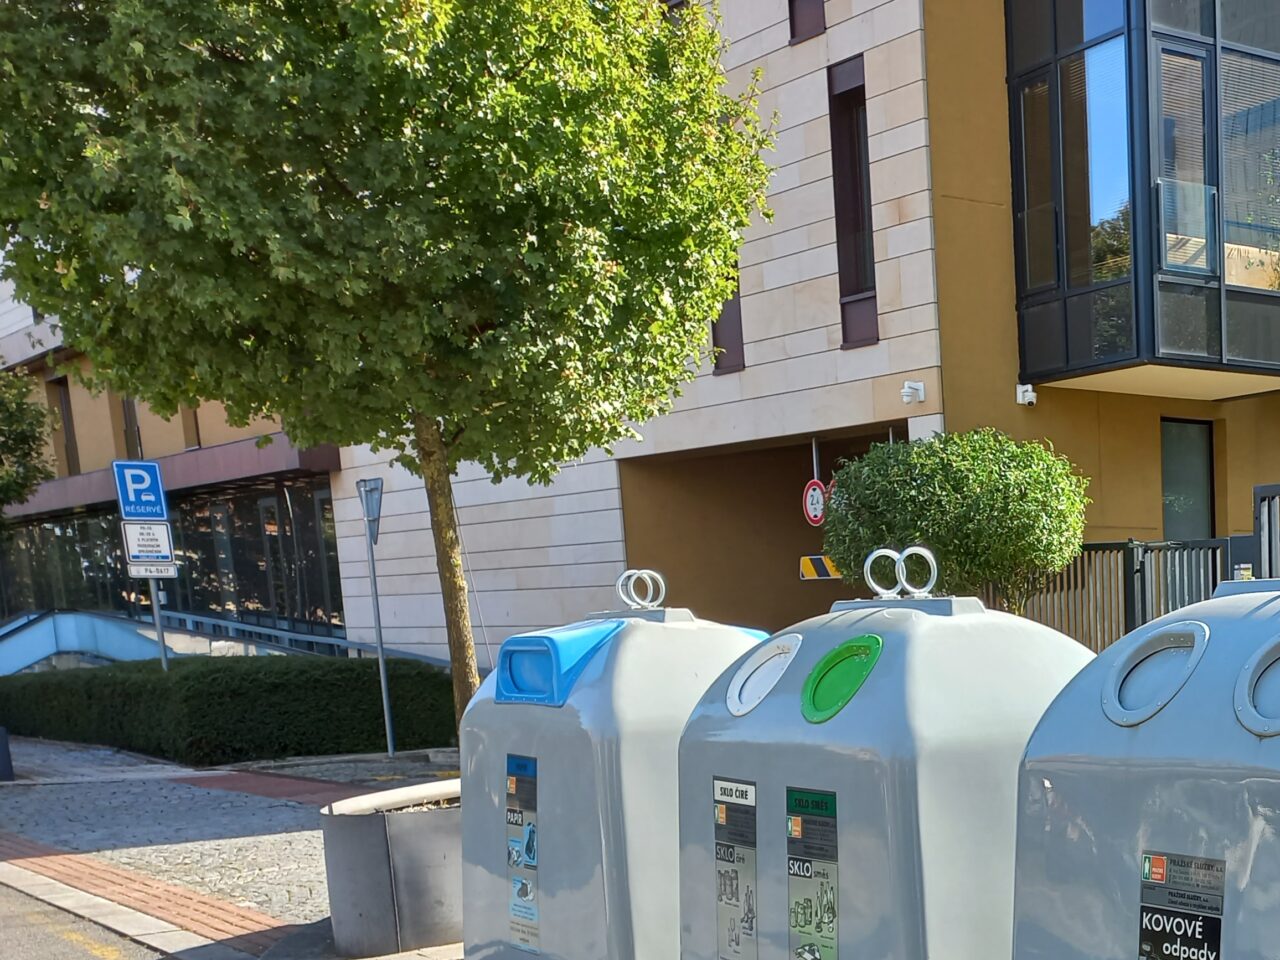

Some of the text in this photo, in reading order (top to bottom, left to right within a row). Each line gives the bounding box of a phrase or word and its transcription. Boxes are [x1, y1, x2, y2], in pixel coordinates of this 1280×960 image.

[124, 469, 151, 501] P
[720, 787, 748, 800] SKLO ČIRÉ
[717, 847, 734, 861] SKLO
[789, 860, 811, 876] SKLO
[1142, 912, 1203, 939] KOVOVÉ
